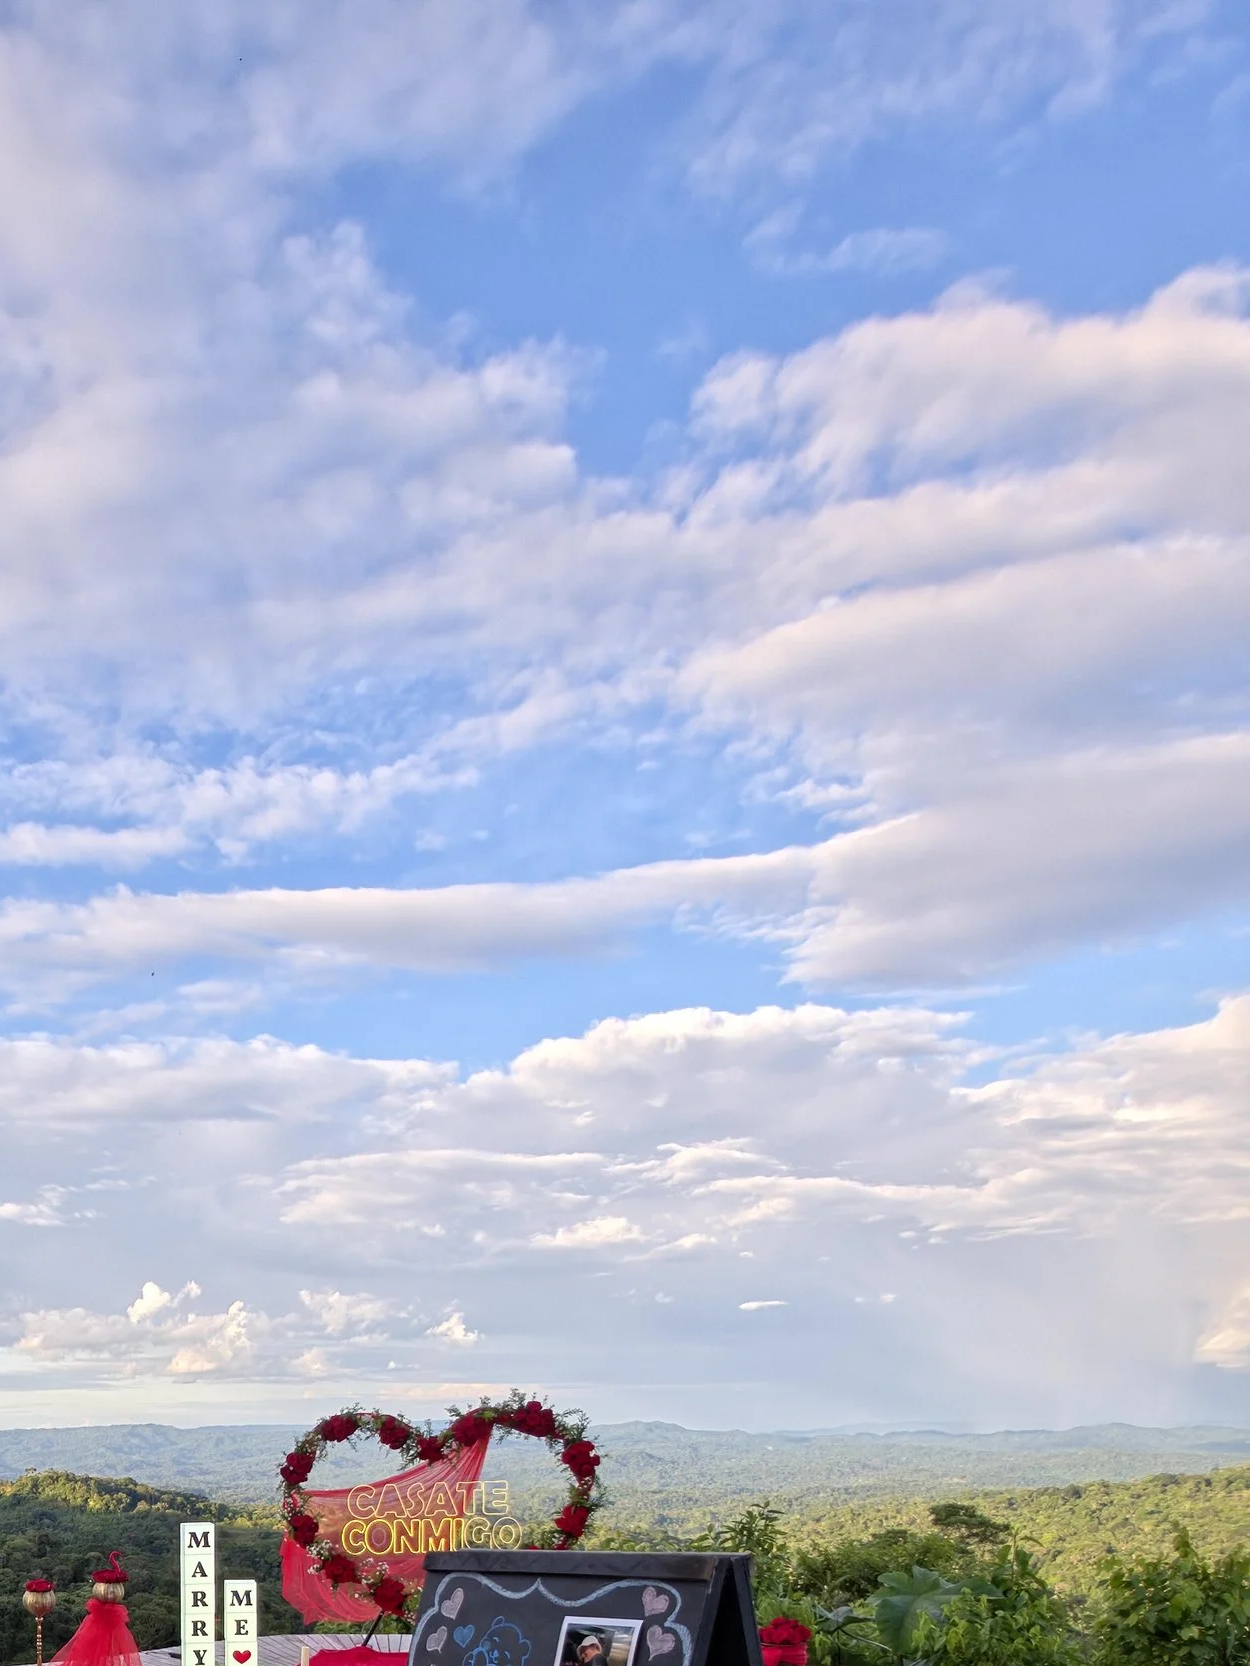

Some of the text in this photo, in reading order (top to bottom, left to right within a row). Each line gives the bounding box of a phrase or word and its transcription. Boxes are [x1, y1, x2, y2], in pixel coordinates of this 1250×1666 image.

[347, 1480, 509, 1519] CASATE
[342, 1516, 523, 1556] CONMIGO
[187, 1530, 211, 1666] MARRY
[229, 1589, 253, 1637] ME
